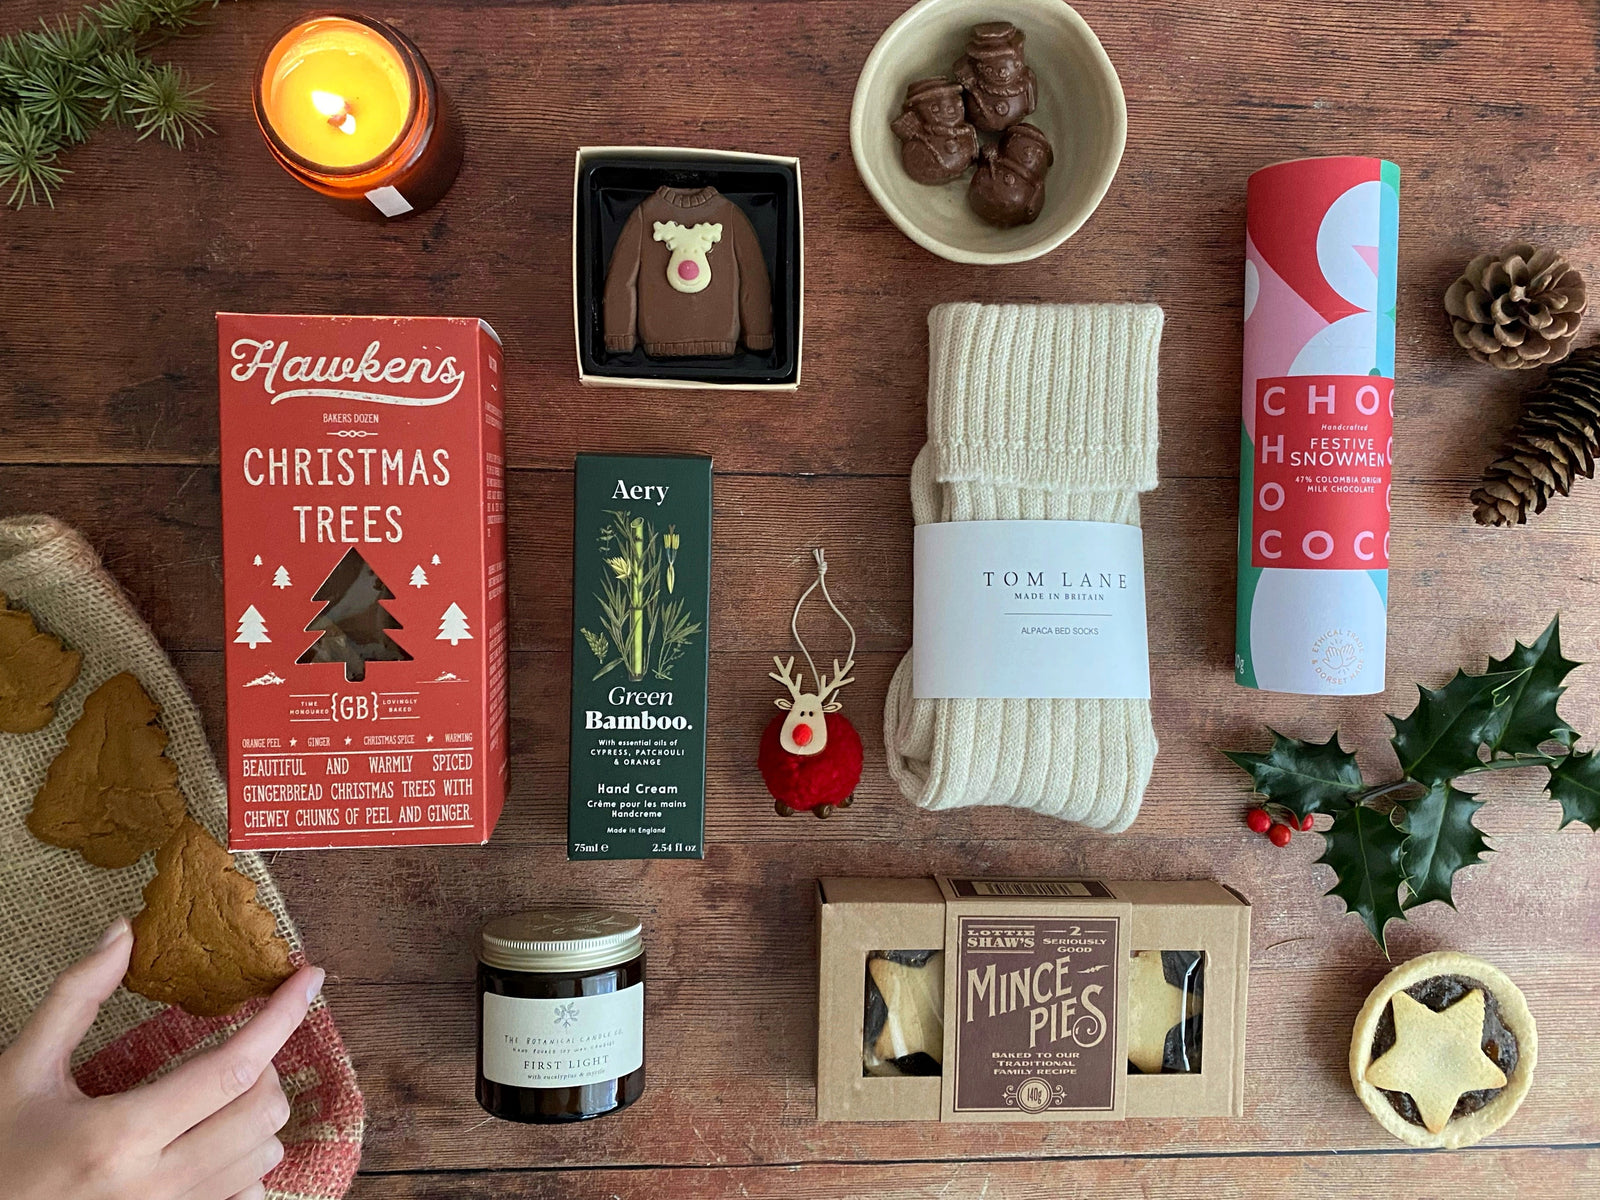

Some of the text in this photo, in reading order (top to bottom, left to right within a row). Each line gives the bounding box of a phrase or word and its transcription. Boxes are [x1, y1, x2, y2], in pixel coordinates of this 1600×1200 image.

[231, 339, 464, 406] Hawkens
[323, 413, 379, 423] BAKERS DOZEN
[1310, 438, 1374, 450] FESTIVE
[1290, 451, 1384, 467] SNOWMEN
[243, 448, 450, 486] CHRISTMAS
[612, 480, 669, 506] Aery
[1307, 485, 1328, 493] MILK
[293, 505, 402, 543] TREES
[983, 571, 1127, 589] TOM LANE
[1064, 593, 1104, 601] BRITAIN
[1021, 627, 1099, 635] ALPACA BED SOCKS
[1312, 629, 1365, 654] ETHICAL TRADE
[1315, 666, 1348, 686] DORSET
[1350, 658, 1365, 680] MADE
[608, 686, 673, 706] Green
[585, 711, 693, 730] Bamboo.
[242, 733, 473, 748] ORANGE PEEL GINGER CHRISTMAS SPICE WARMING
[242, 754, 473, 777] BEAUTIFUL AND WARMLY SPICED
[243, 779, 473, 803] GINGERBREAD CHRISTMAS TREES WITH
[598, 784, 678, 794] Hand Cream
[587, 800, 687, 810] Crème pour les mains
[244, 804, 473, 828] CHEWEY CHUNKS OF PEEL AND GINGER.
[611, 810, 662, 818] Handcreme
[638, 827, 666, 835] England
[574, 843, 598, 852] 75ml
[652, 843, 672, 852] 2.54
[675, 843, 682, 852] fl
[1069, 927, 1082, 936] 2
[967, 937, 1035, 948] SHAW'S
[966, 955, 1072, 1023] MINCE
[1029, 984, 1107, 1049] PIES
[504, 1034, 519, 1044] THE
[527, 1037, 575, 1046] BOTANICAL
[579, 1032, 611, 1043] CANDLE
[524, 1055, 610, 1070] FIRST LIGHT
[543, 1072, 577, 1081] eucalyptus
[1026, 1087, 1042, 1104] 140g
